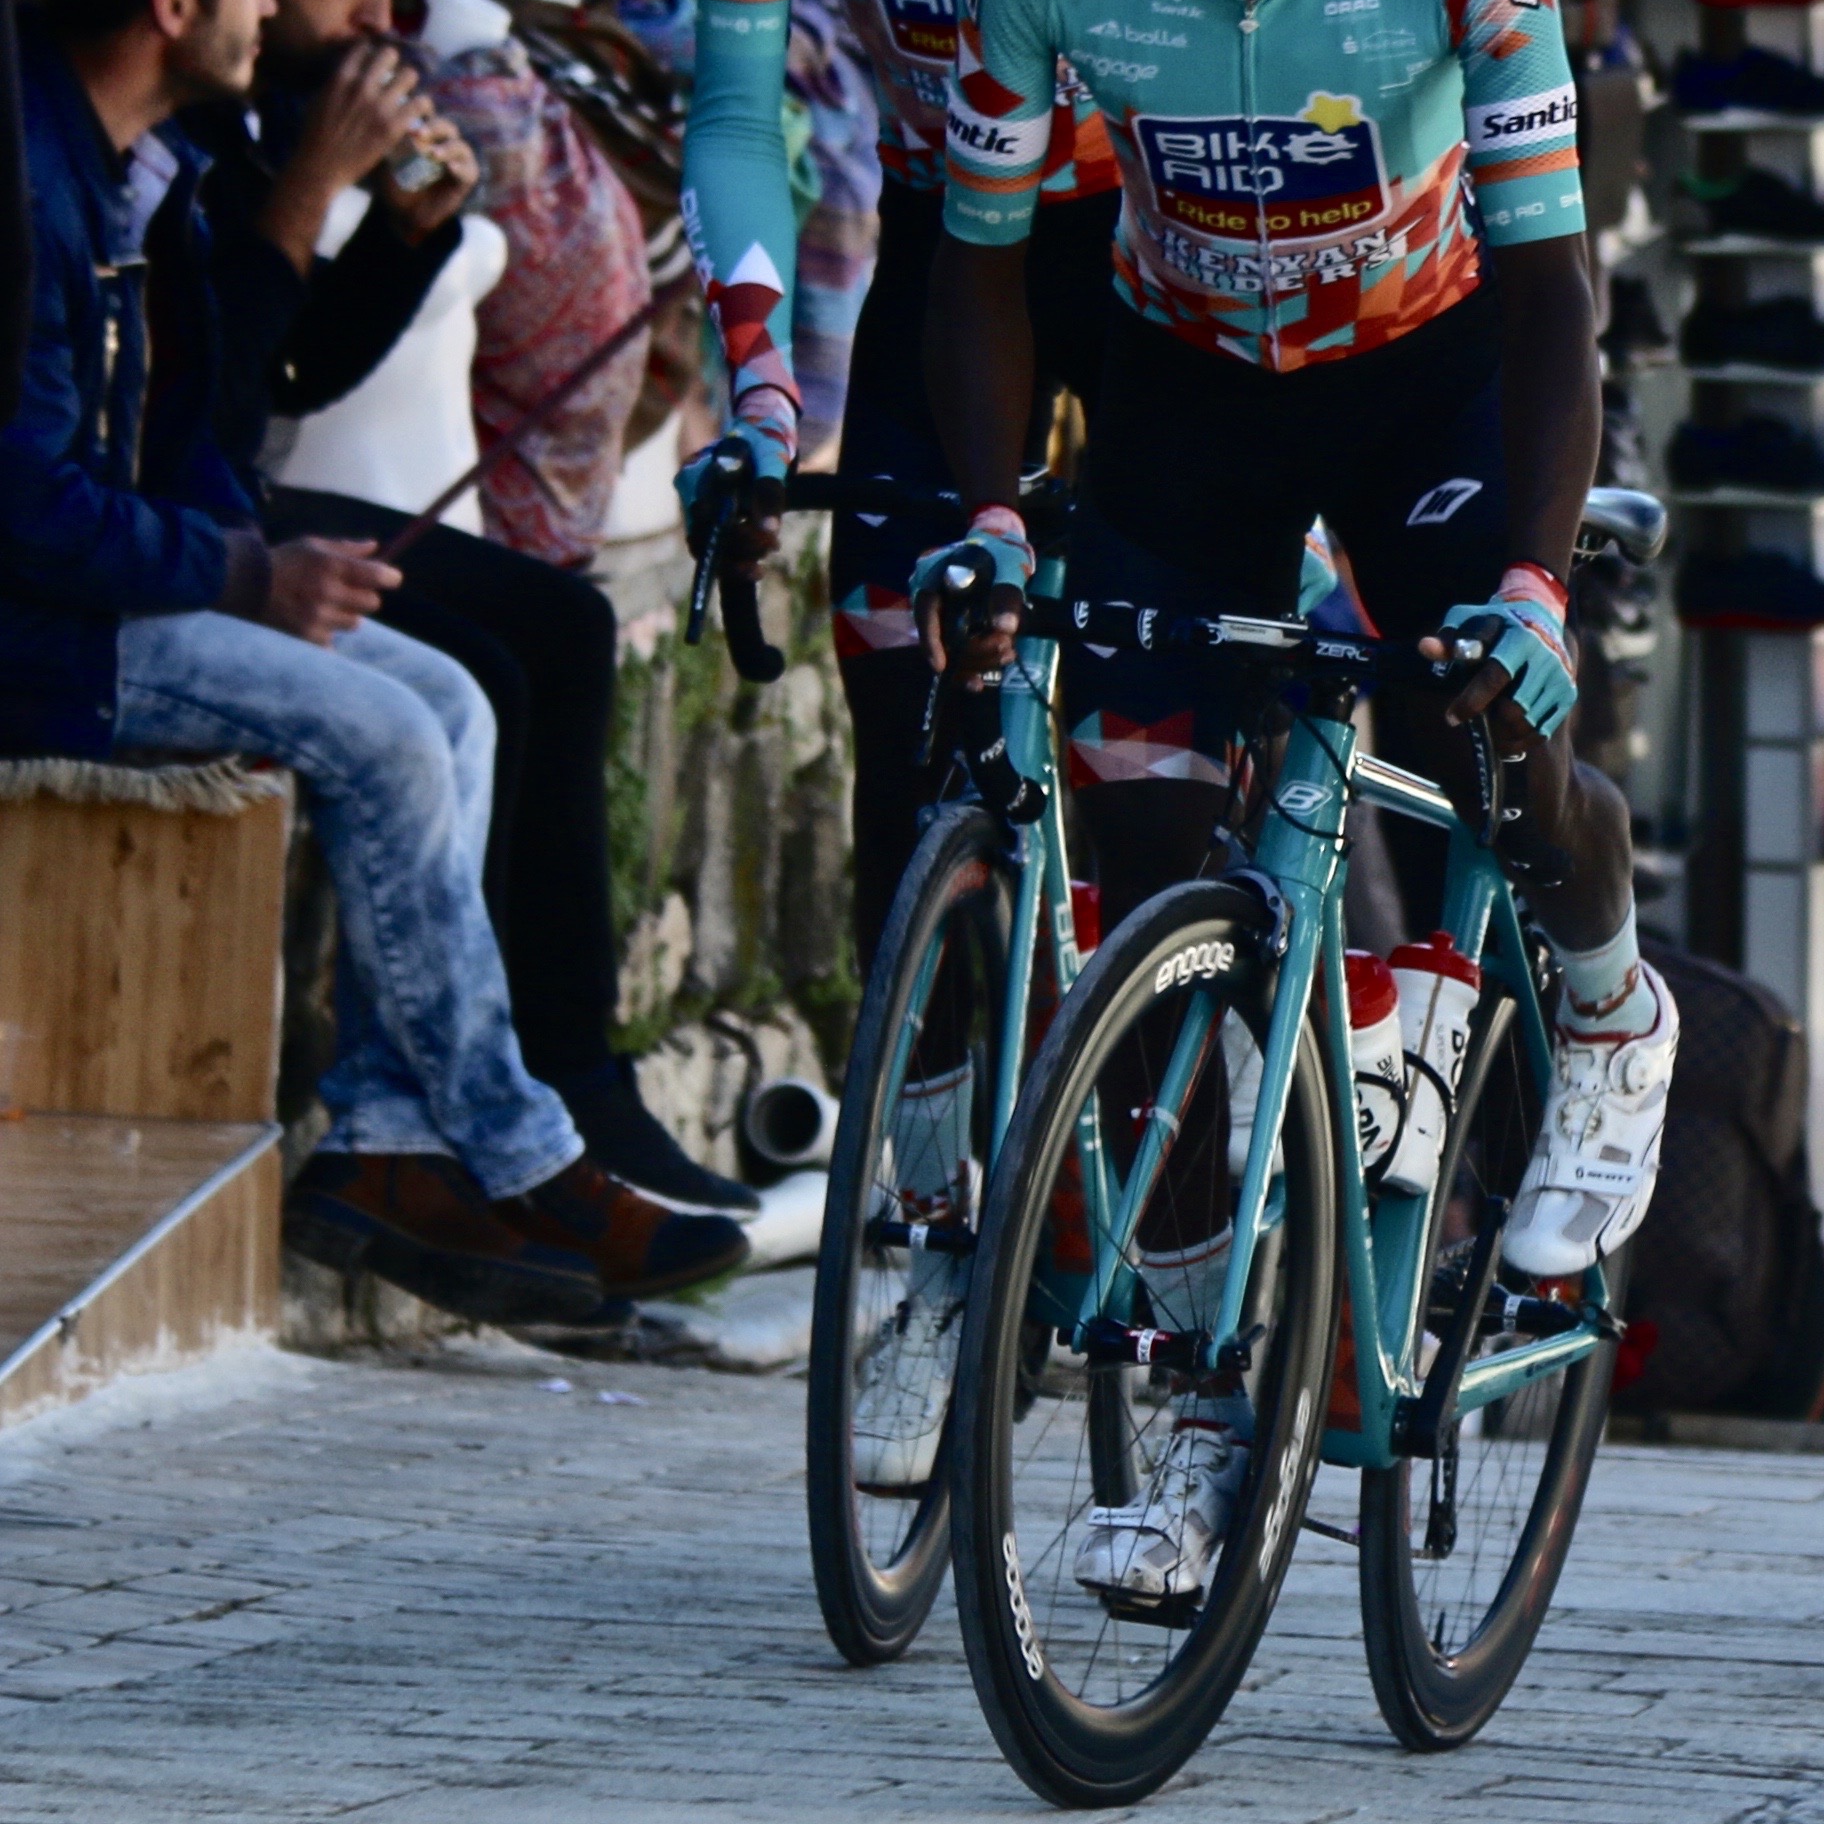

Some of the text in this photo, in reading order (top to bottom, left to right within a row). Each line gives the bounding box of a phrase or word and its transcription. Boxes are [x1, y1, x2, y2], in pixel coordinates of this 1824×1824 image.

[1068, 47, 1160, 83] engage
[1162, 158, 1285, 196] AID
[1176, 199, 1248, 232] Ride
[1299, 199, 1373, 227] help
[1160, 228, 1388, 277] KENYAN
[1154, 941, 1236, 995] engage
[1000, 1531, 1044, 1681] engage
